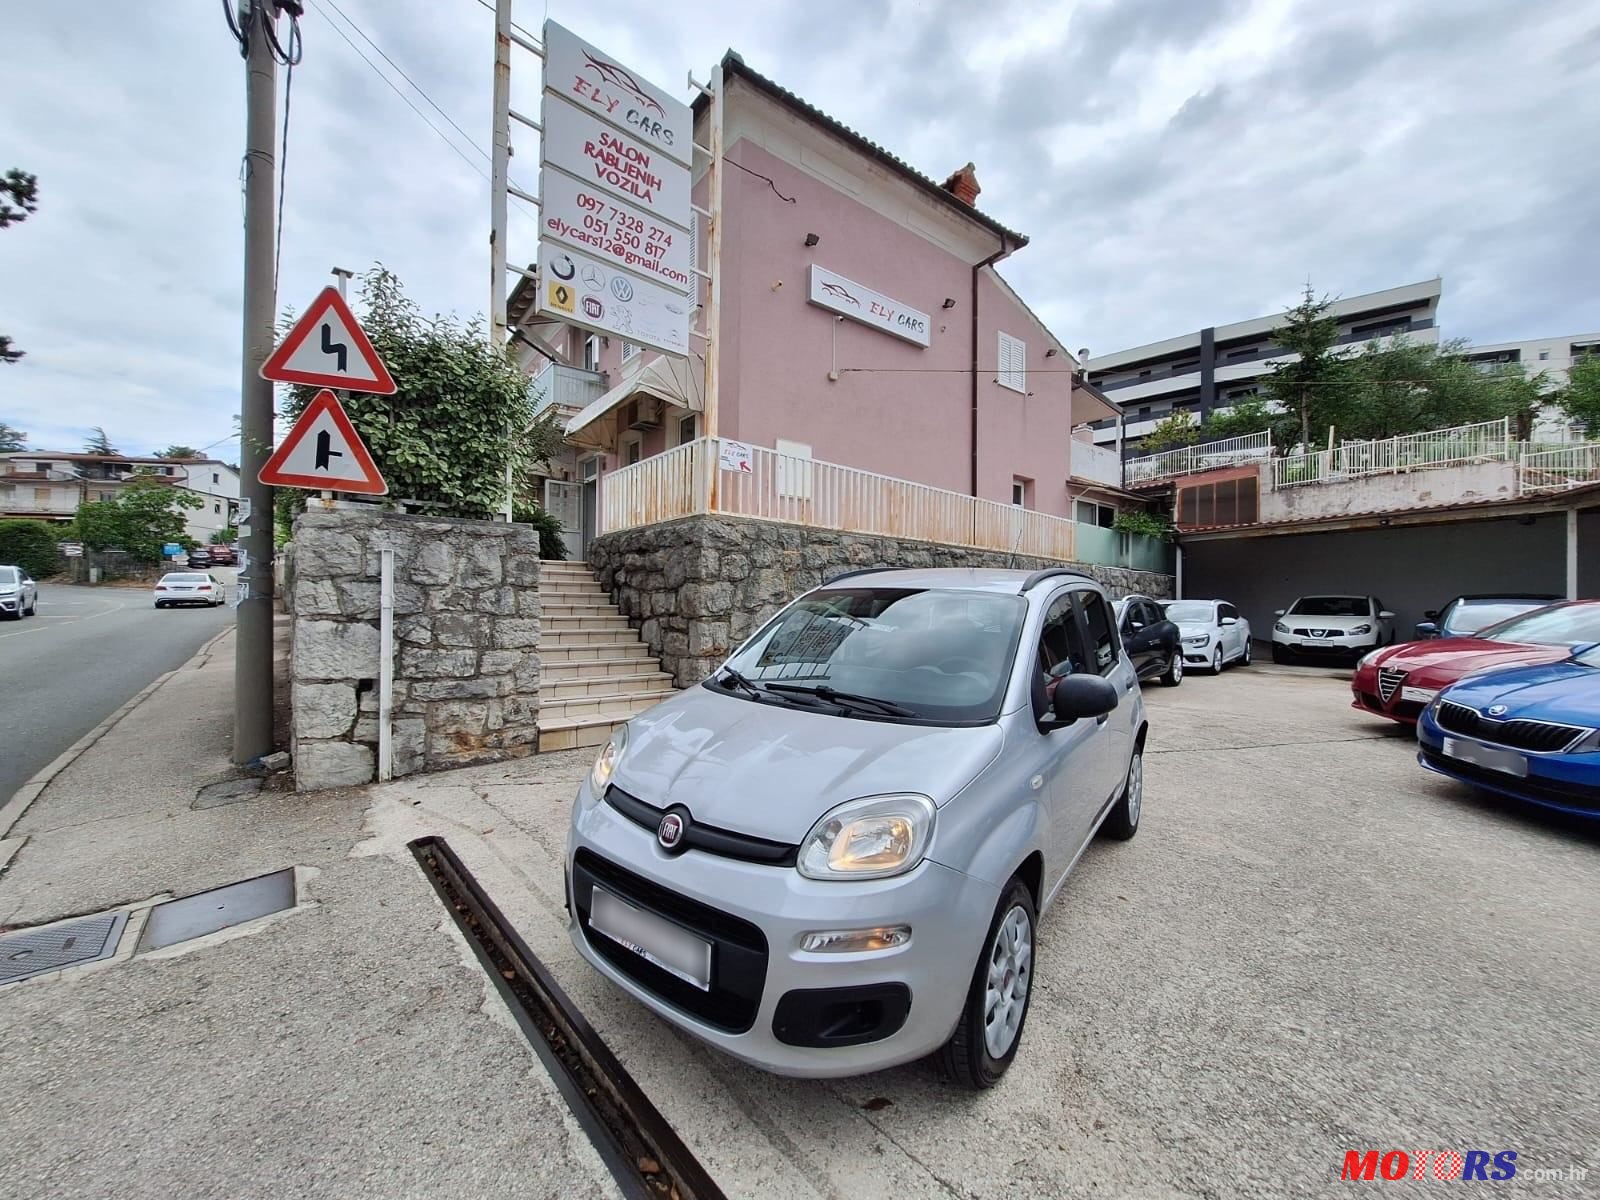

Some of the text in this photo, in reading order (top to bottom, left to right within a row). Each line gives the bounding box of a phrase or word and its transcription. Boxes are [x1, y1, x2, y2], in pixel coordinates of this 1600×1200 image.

[573, 75, 675, 146] ELY CARS
[584, 141, 662, 191] RABLJENIH
[598, 132, 650, 168] SALON
[594, 163, 653, 203] VOZILA
[577, 193, 672, 247] 097 7328 274
[584, 215, 666, 259] 051 550 817
[547, 217, 688, 284] elycars12@gmail.com
[585, 300, 601, 317] FIAT
[869, 301, 924, 333] ELY CARS
[663, 822, 679, 840] FIAT
